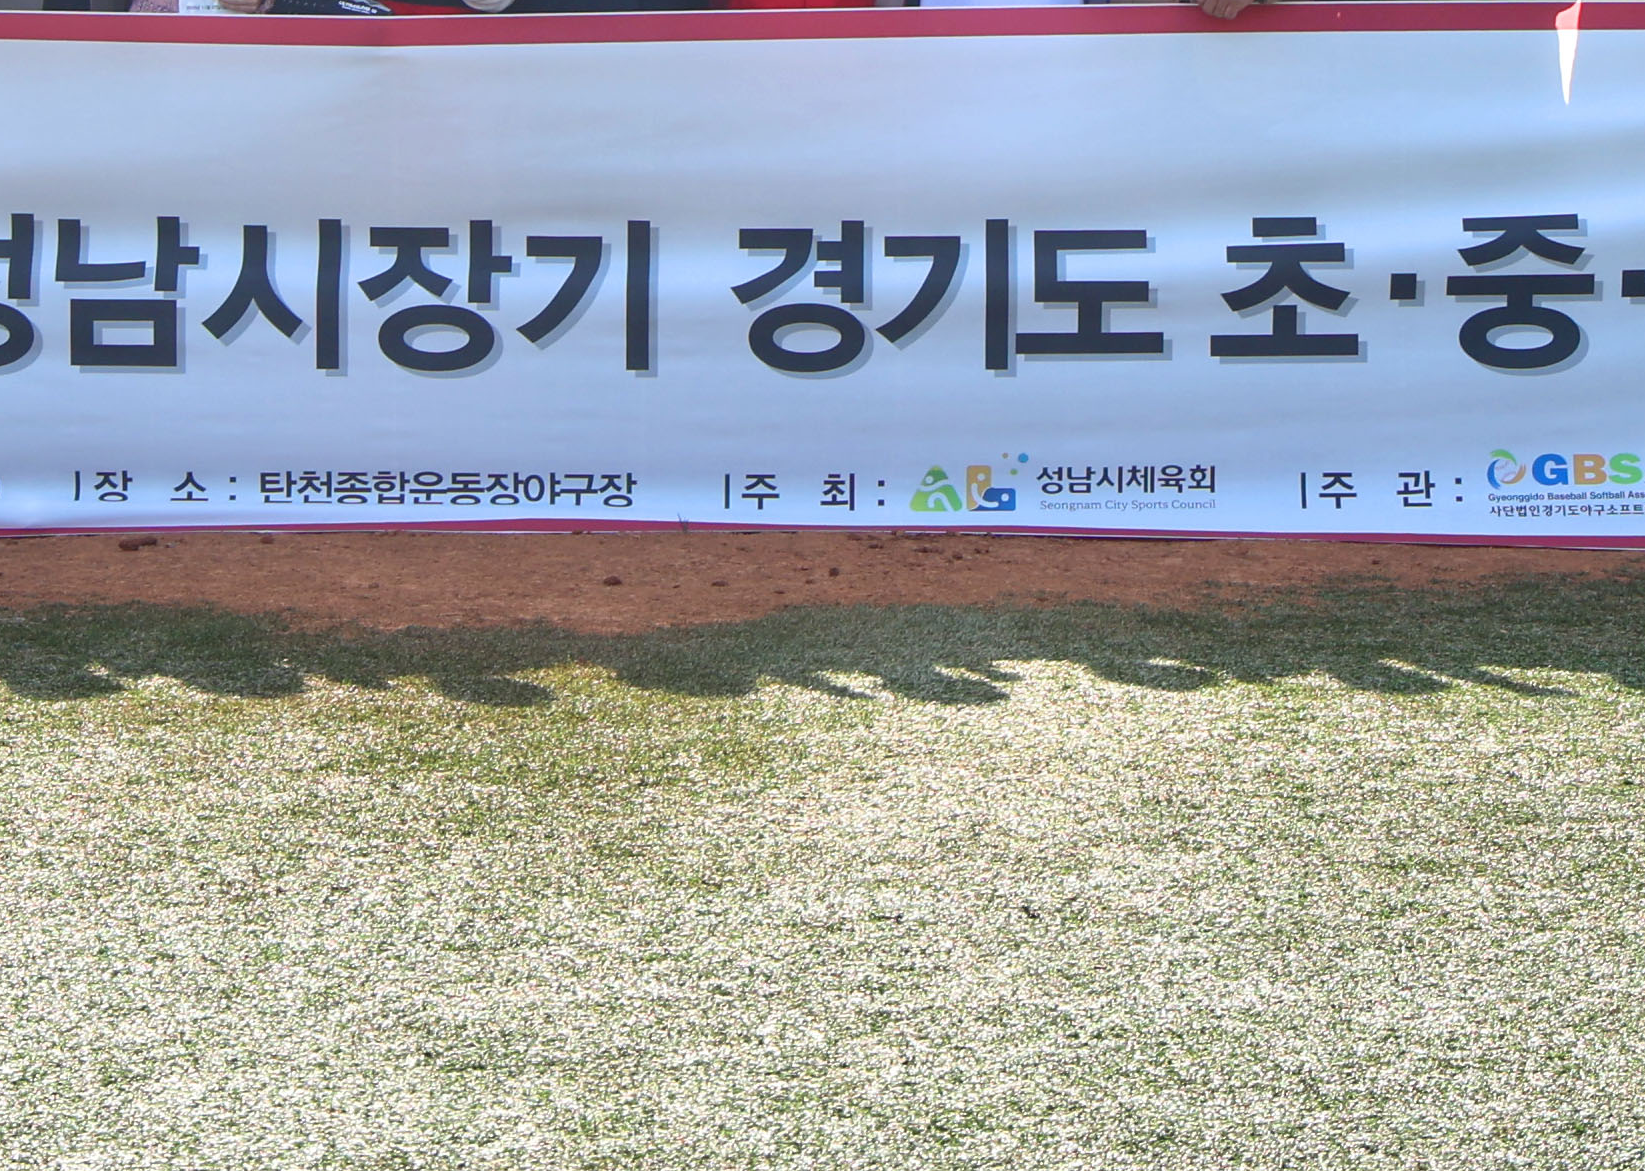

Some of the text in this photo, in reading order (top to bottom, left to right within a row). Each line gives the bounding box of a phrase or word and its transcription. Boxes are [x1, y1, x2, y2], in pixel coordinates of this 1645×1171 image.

[731, 218, 1168, 376] 경기도
[94, 470, 133, 503] 장
[170, 471, 209, 502] 소
[260, 470, 638, 508] 탄천종합운동장야구장
[741, 473, 780, 510] 주
[820, 473, 855, 511] 최
[1036, 464, 1216, 495] 성남시체육회
[1040, 499, 1216, 512] Seongnam City Sports Council
[1318, 472, 1358, 509] 주
[1396, 470, 1436, 508] 관
[1488, 492, 1545, 503] Gyeonggido
[1547, 491, 1587, 501] Baseball
[1589, 491, 1626, 500] Softball
